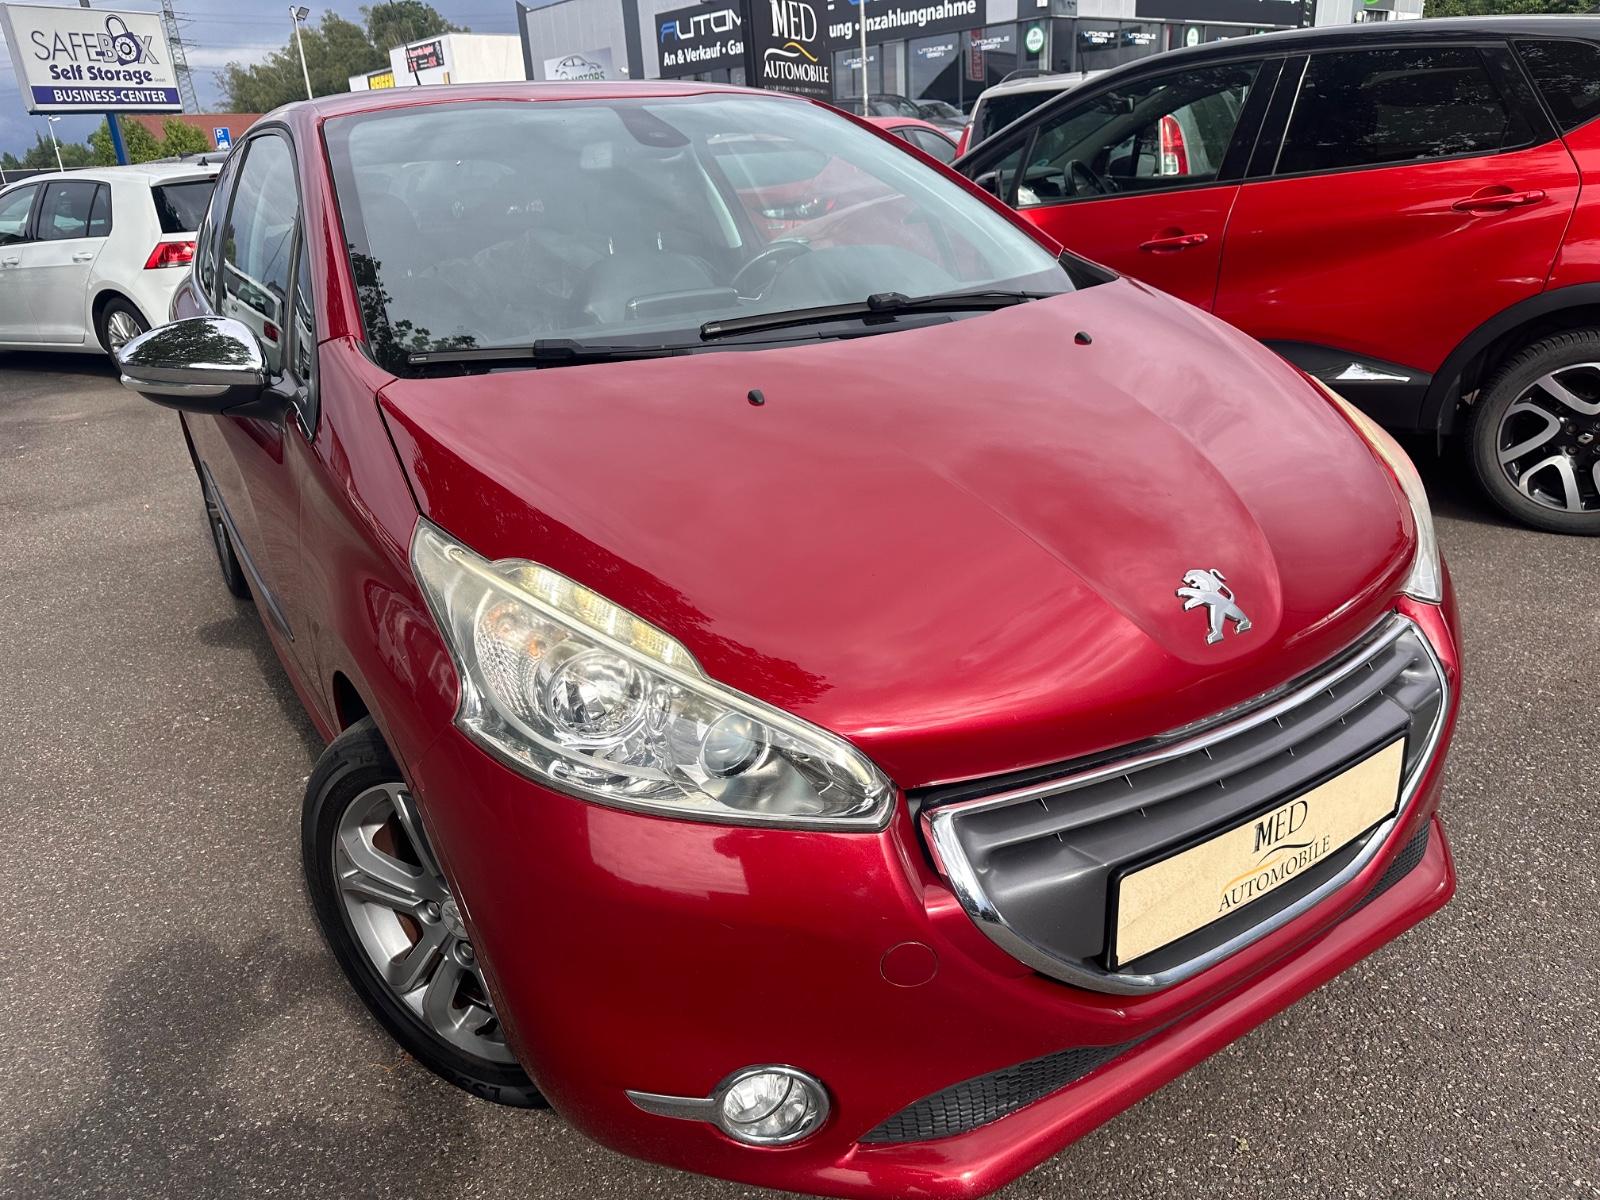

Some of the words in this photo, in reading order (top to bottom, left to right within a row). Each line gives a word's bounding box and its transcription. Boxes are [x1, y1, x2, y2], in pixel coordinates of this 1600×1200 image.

[771, 0, 818, 42] MED
[829, 23, 853, 38] ung
[663, 52, 676, 67] An
[677, 52, 685, 64] &
[684, 44, 721, 63] Verkauf
[49, 64, 84, 81] Self
[87, 66, 153, 85] Storage
[763, 61, 830, 84] AUTOMOBILE
[53, 89, 167, 103] BUSINESS-CENTER
[1252, 800, 1308, 854] MED
[1218, 834, 1331, 913] AUTOMOBILE
